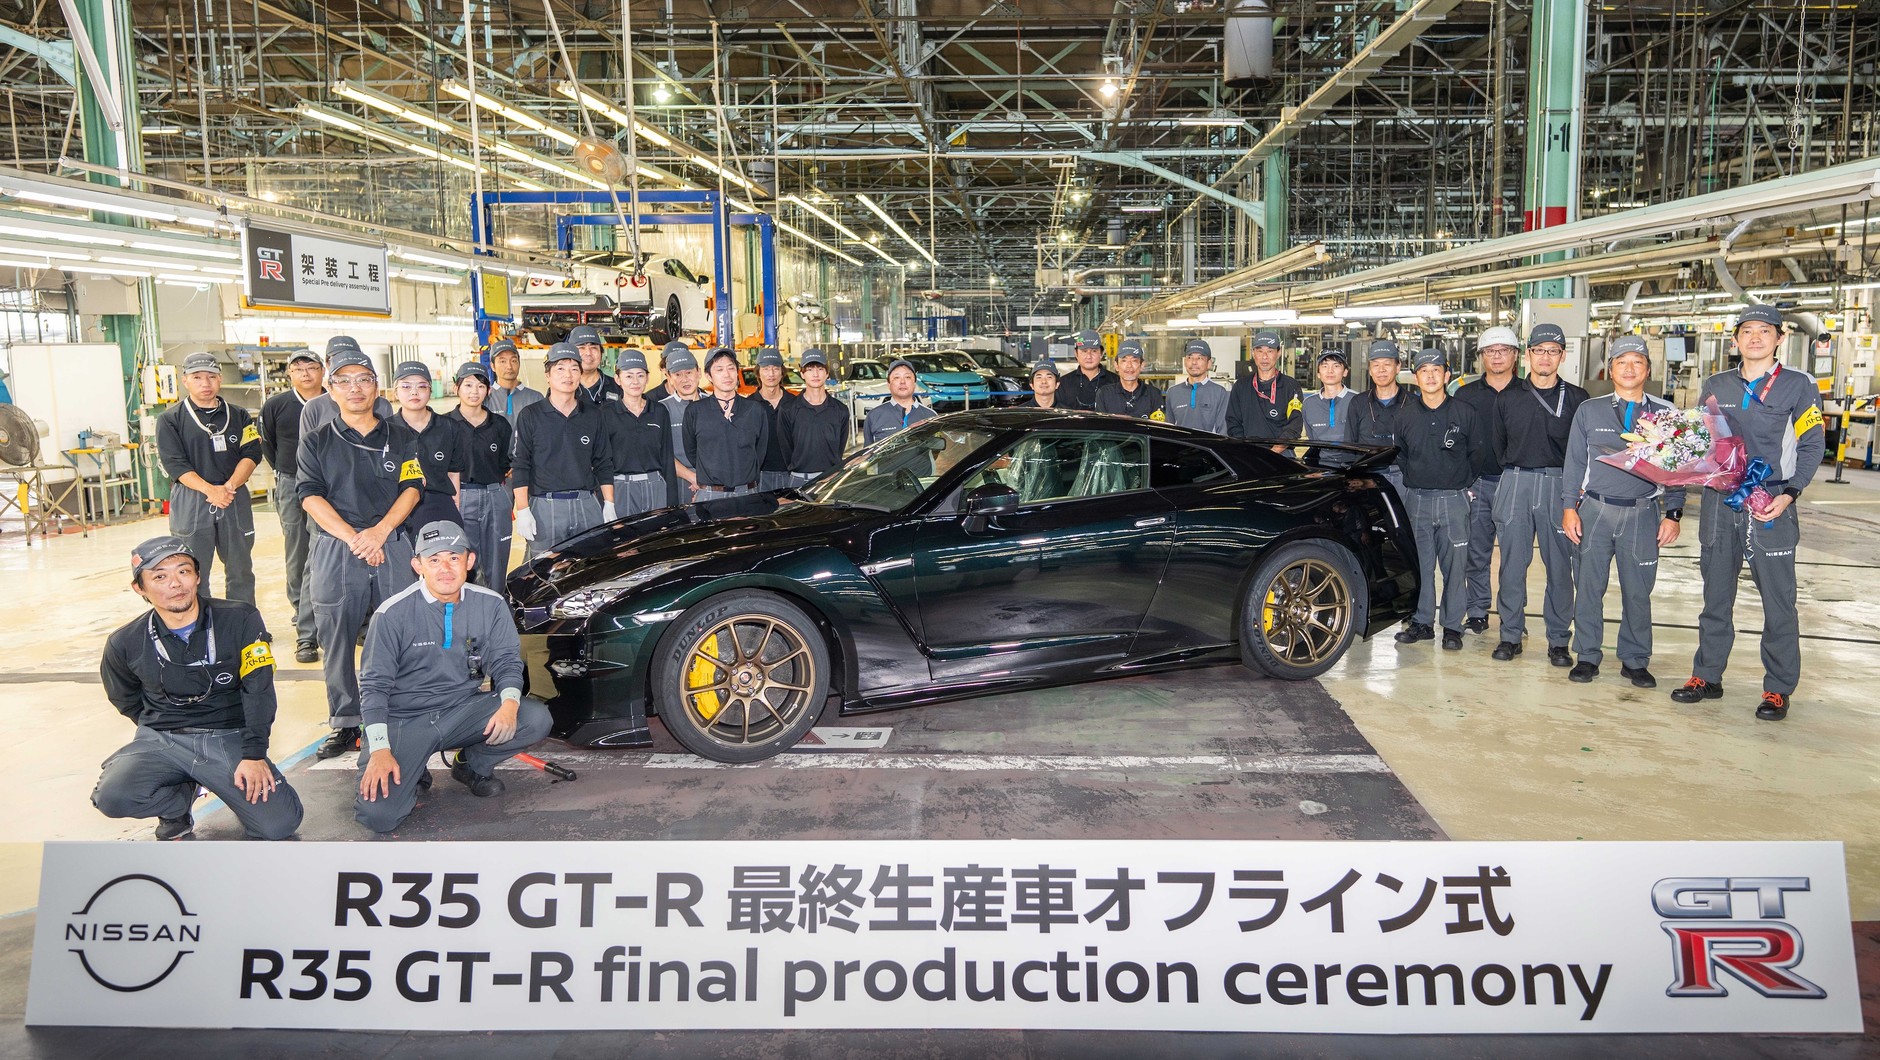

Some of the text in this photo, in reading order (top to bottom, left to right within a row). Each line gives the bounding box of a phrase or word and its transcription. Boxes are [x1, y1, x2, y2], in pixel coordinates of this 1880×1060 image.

[257, 247, 283, 260] GT
[259, 259, 286, 281] R
[301, 254, 379, 282] 架装工程
[302, 277, 320, 286] Special
[330, 281, 348, 289] delivery
[348, 283, 370, 291] assembly
[149, 544, 178, 554] NISSAN
[428, 535, 455, 543] NISSAN
[673, 606, 728, 663] DUNLOP
[335, 864, 1514, 936] R35 GT-R 最終生産車オフライン式
[1651, 877, 1810, 919] GT
[65, 923, 200, 942] NISSAN
[1660, 920, 1828, 999] R
[240, 946, 1612, 1020] R35 GT-R final production ceremony
